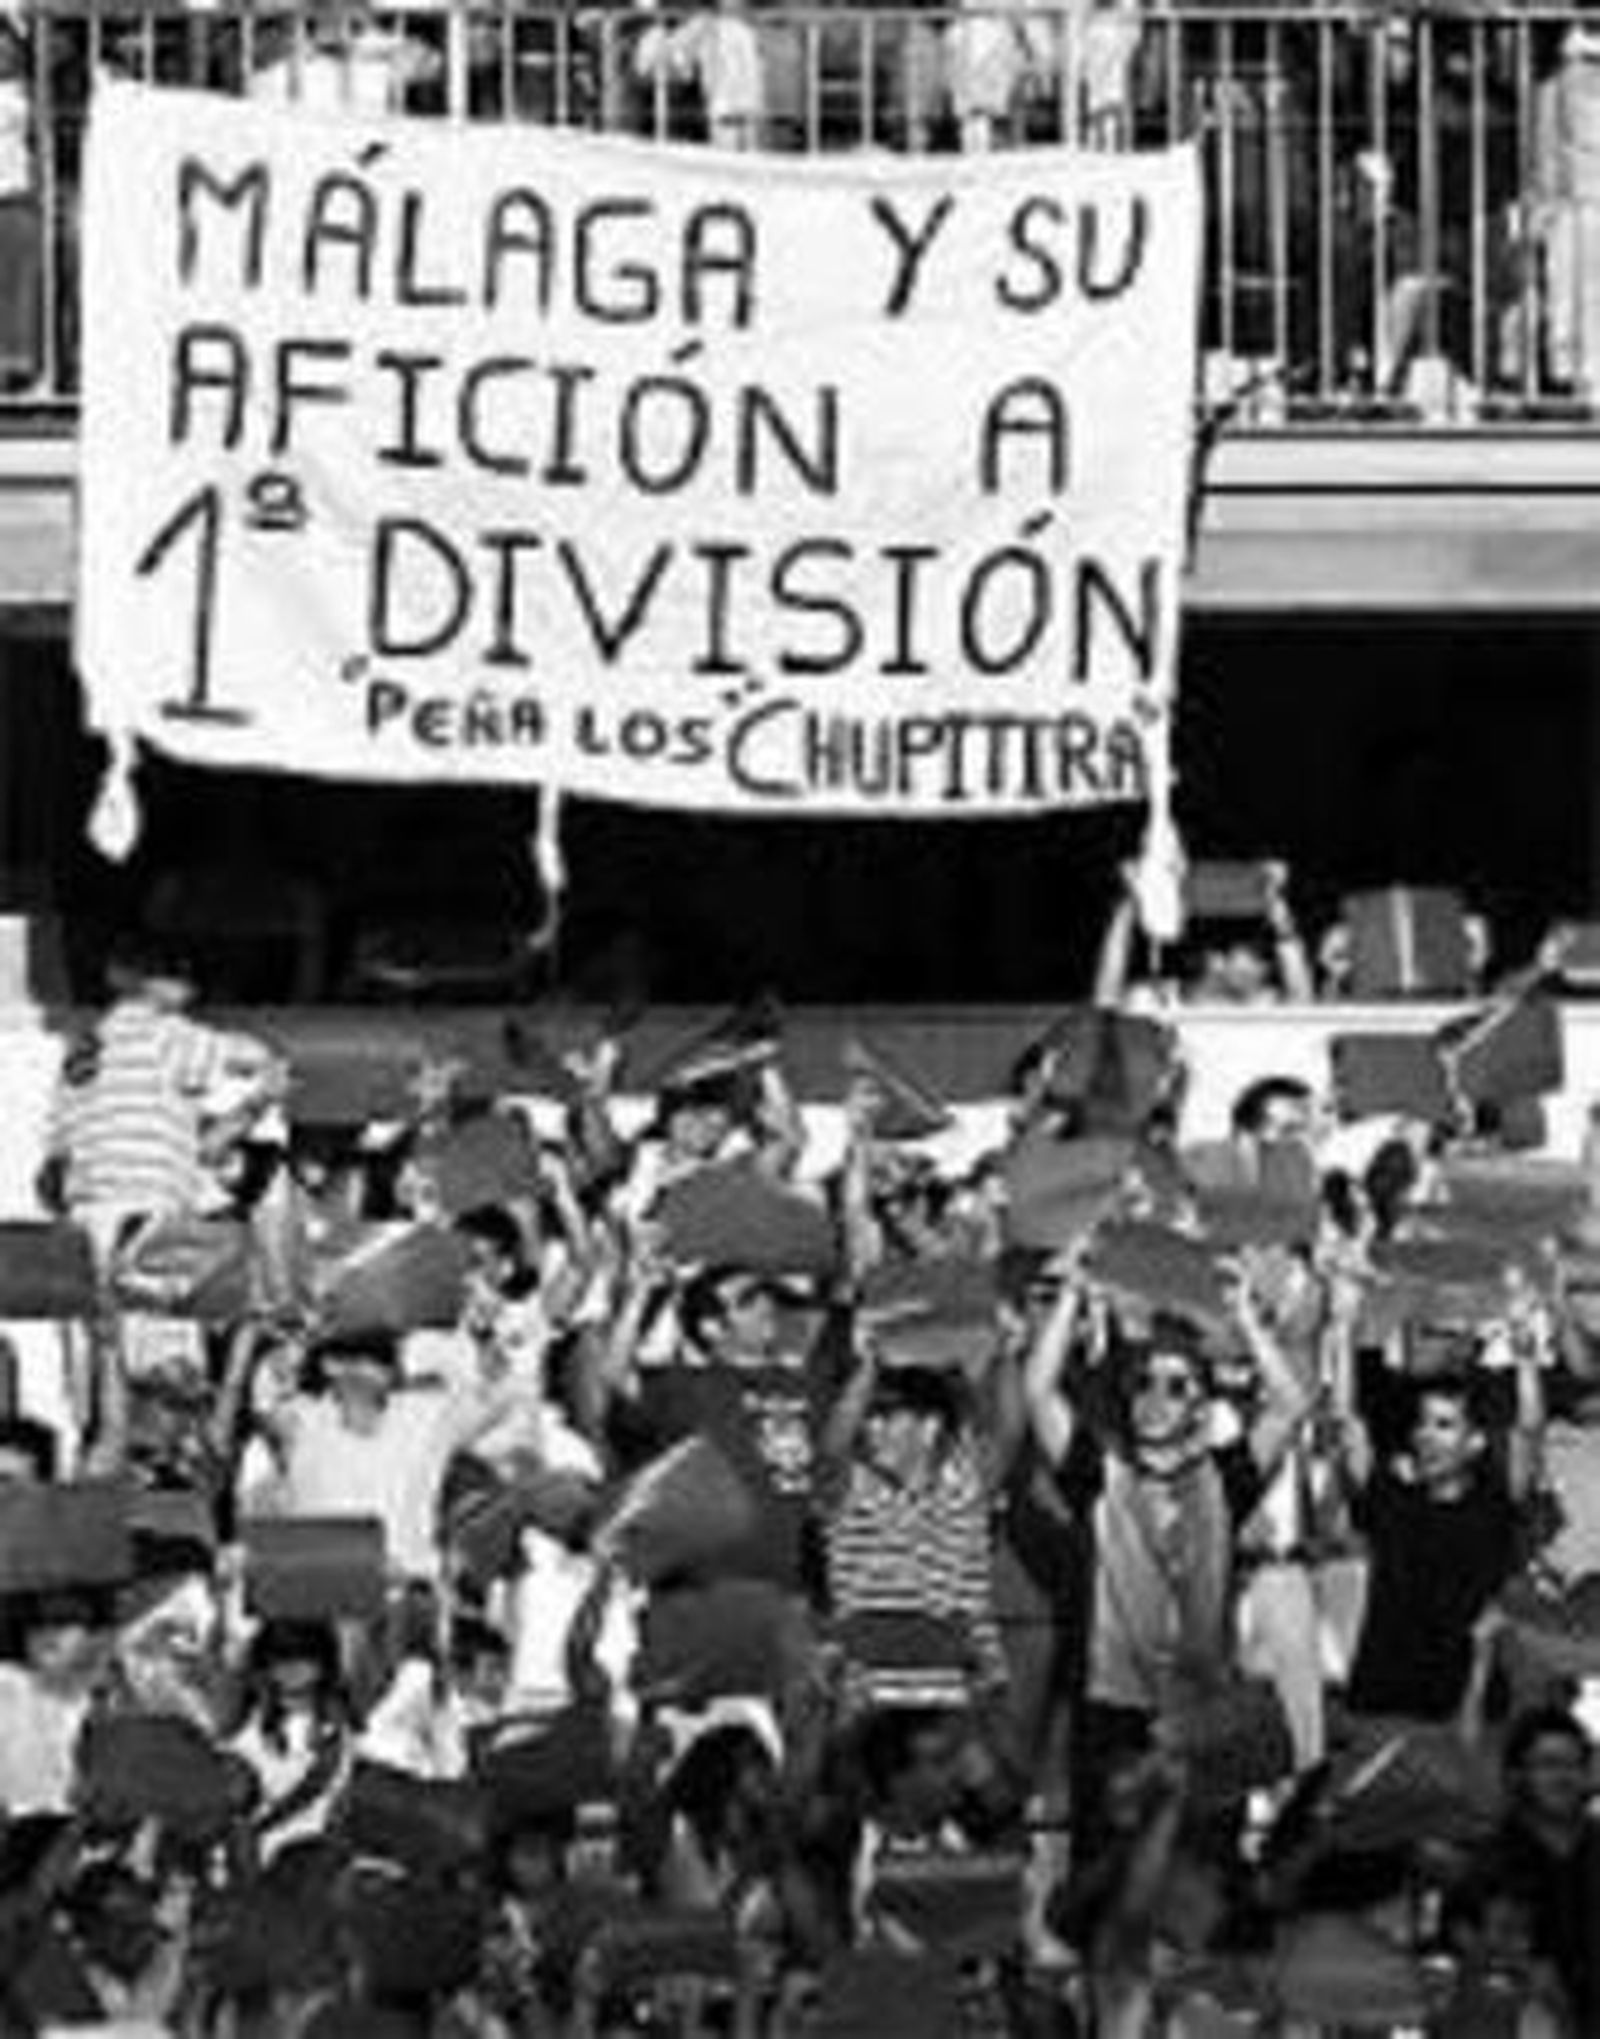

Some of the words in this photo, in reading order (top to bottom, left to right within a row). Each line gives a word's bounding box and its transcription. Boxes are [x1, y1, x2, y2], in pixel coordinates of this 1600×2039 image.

[177, 141, 757, 329] MÁLAGA
[868, 193, 954, 318] Y
[996, 193, 1148, 313] SU
[169, 322, 840, 497] AFICIÓN
[979, 374, 1069, 497] A
[367, 510, 1160, 684] DIVISIÓN
[573, 703, 714, 766] LOS
